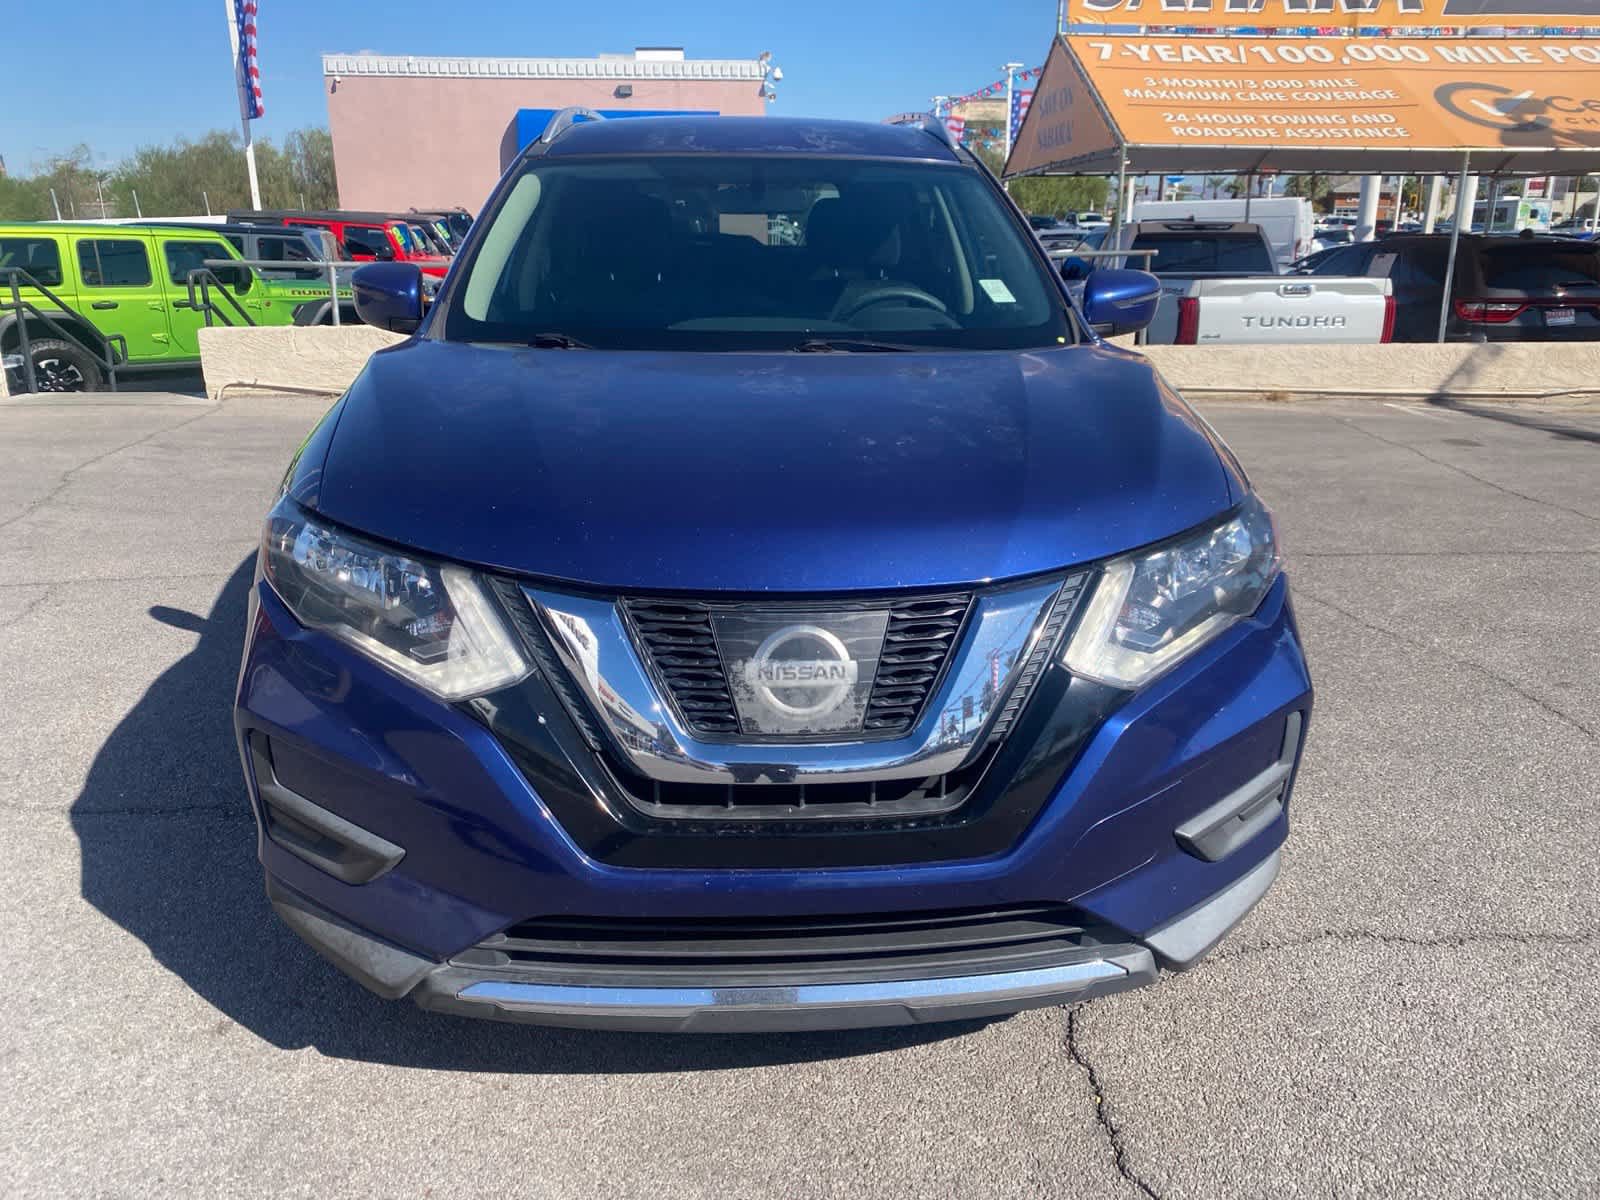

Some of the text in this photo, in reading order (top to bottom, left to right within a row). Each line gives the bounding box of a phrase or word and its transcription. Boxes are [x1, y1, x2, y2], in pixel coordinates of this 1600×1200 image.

[1434, 45, 1542, 64] MILE
[1123, 88, 1400, 101] MAXIMUM CARE COVERAGE
[1162, 112, 1396, 124] 24-HOUR TOWING AND
[1171, 126, 1411, 138] ROADSIDE ASSISTANCE
[1241, 315, 1346, 328] TUNDRA
[757, 664, 847, 681] NISSAN
